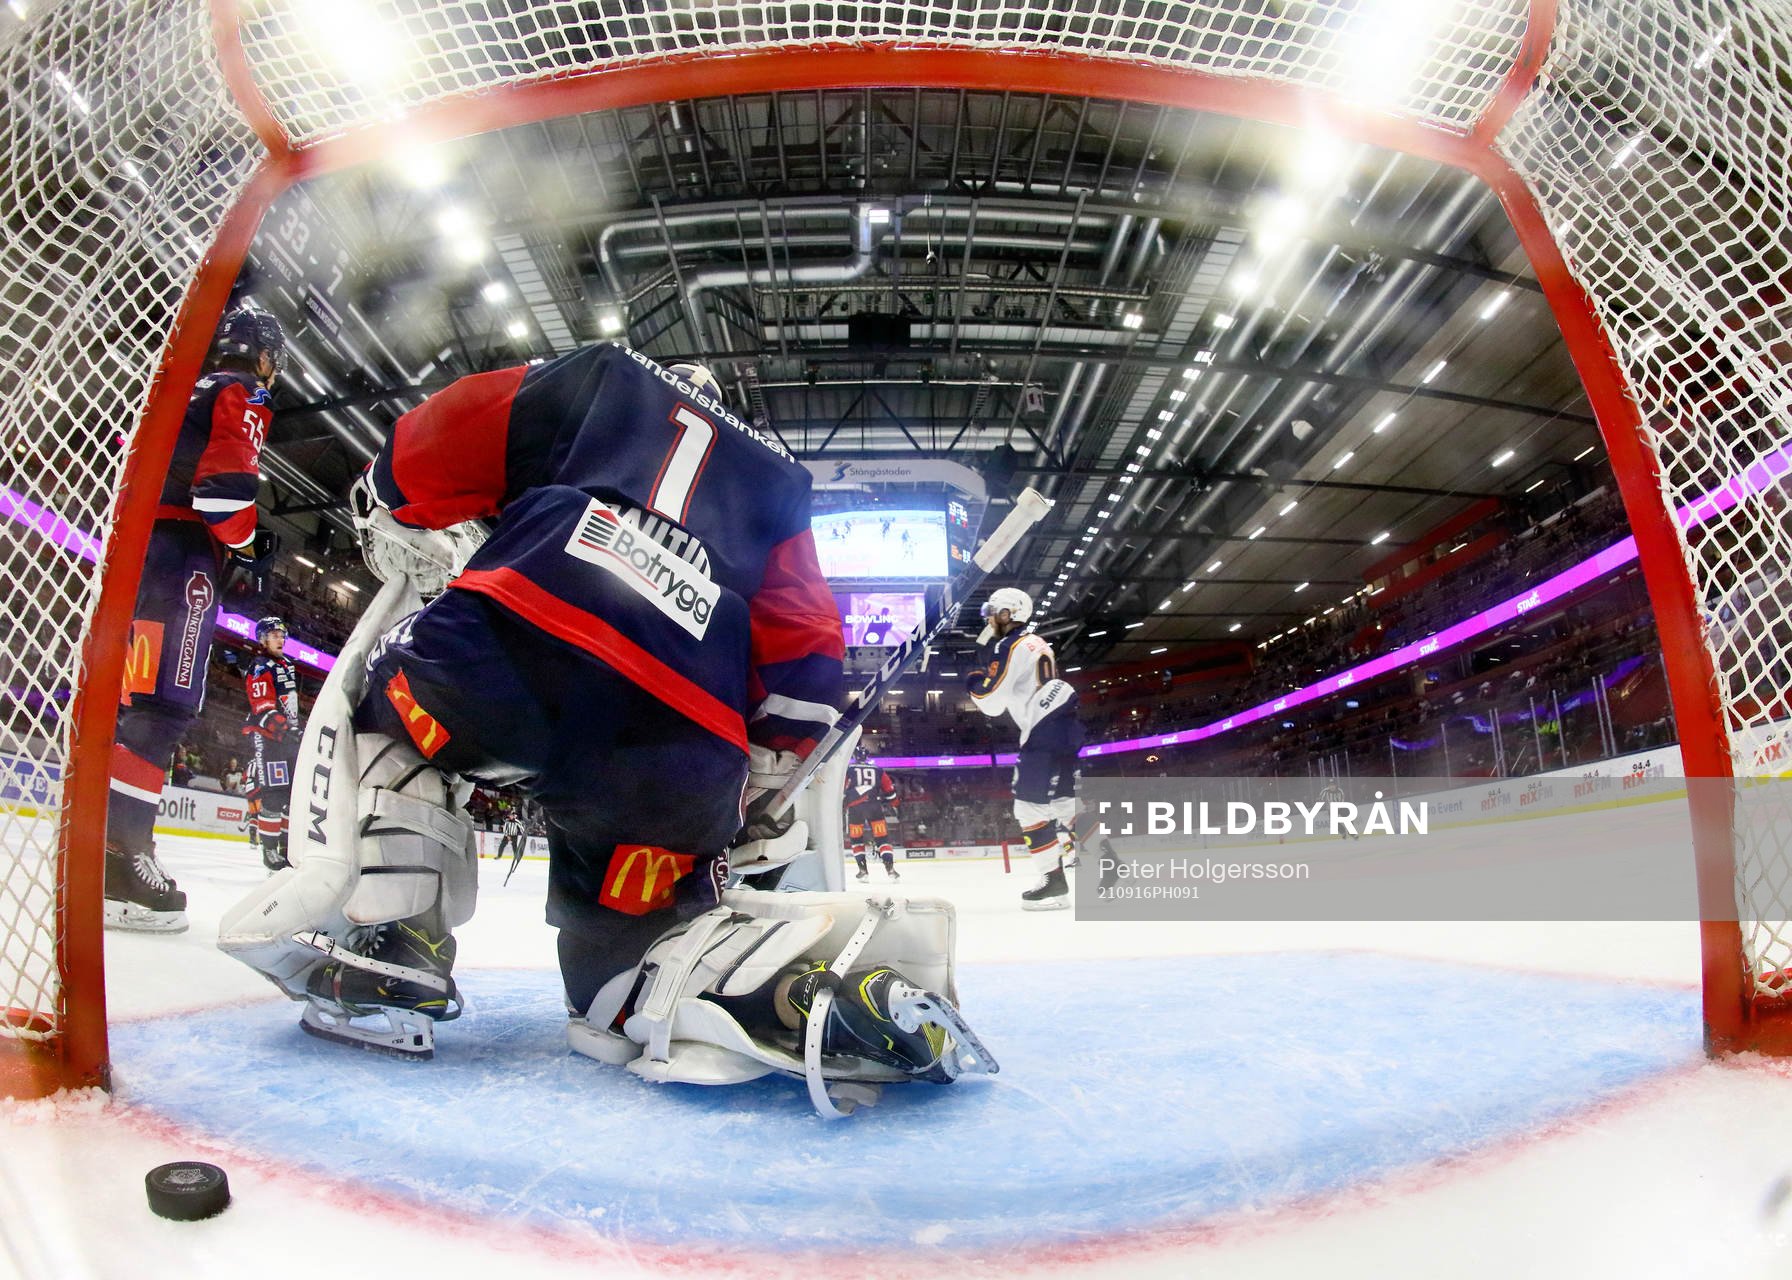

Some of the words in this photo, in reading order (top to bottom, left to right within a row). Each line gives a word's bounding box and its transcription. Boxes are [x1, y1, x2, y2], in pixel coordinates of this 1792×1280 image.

[243, 409, 265, 454] 55
[646, 402, 719, 527] 1
[850, 467, 912, 478] Stångåstaden
[612, 529, 712, 625] Botrygg
[845, 614, 899, 624] BOWLING
[179, 585, 209, 684] TEKNIKBYGGARNA
[859, 623, 926, 710] CCM
[252, 681, 268, 698] 37
[854, 767, 876, 786] 19
[1632, 760, 1651, 773] 94.4
[308, 725, 337, 845] CCM
[218, 809, 241, 819] CCM
[908, 849, 934, 858] stadium
[803, 974, 815, 1006] CCM
